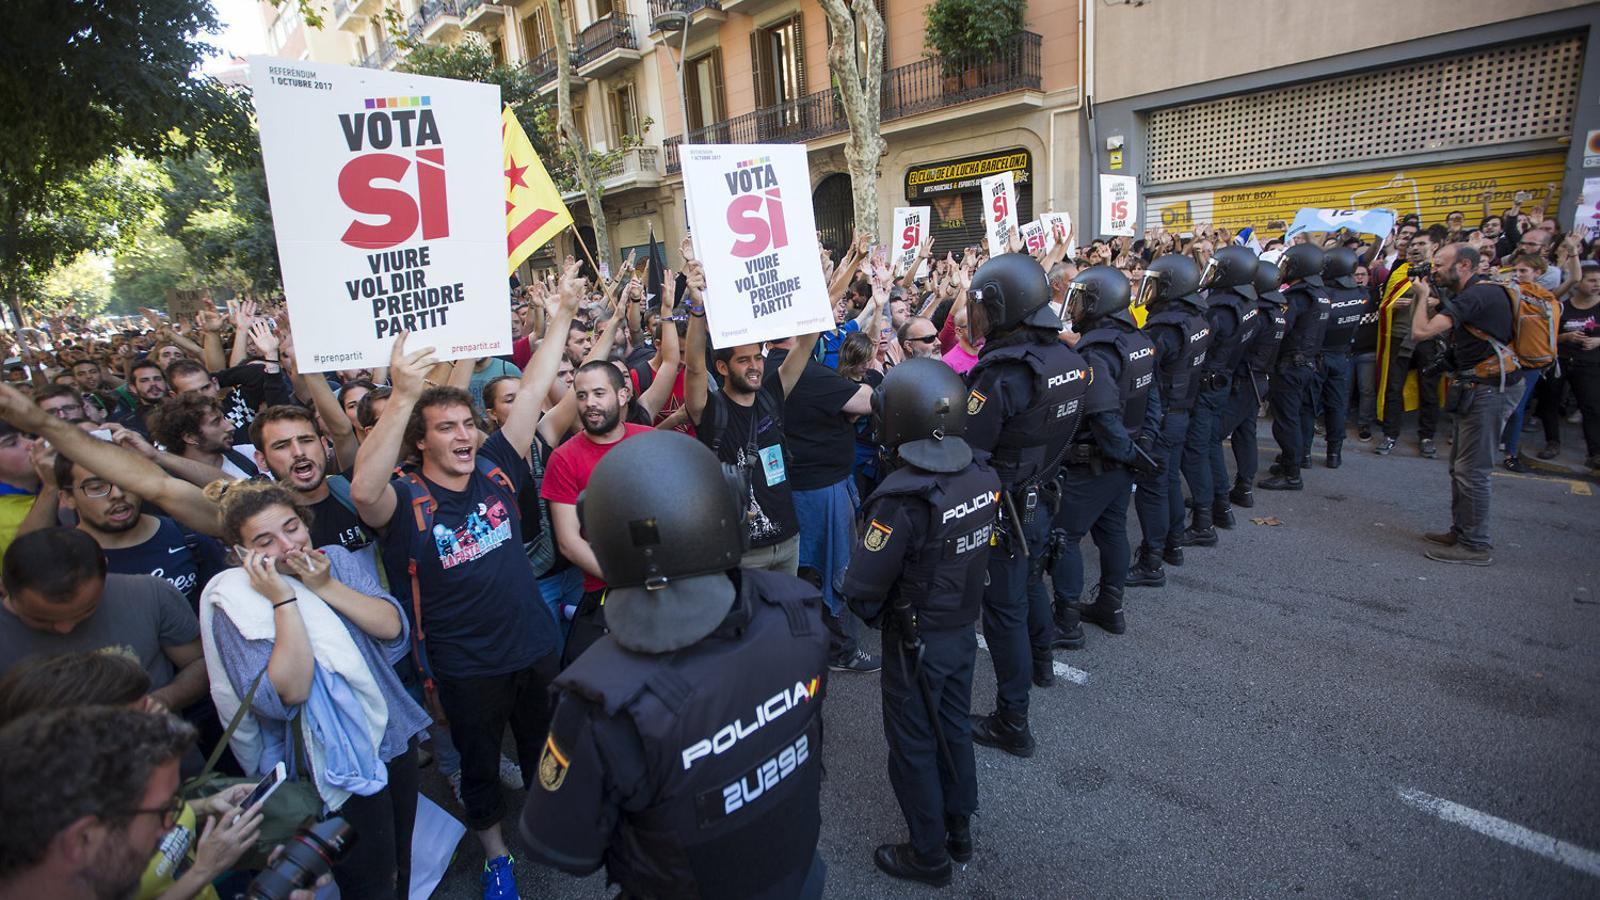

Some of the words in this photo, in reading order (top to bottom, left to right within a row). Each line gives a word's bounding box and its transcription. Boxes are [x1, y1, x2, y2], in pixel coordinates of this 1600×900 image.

[269, 66, 317, 79] REFERENDUM
[271, 76, 275, 84] 1
[277, 77, 313, 89] OCTUBRE
[314, 81, 332, 91] 2017
[338, 109, 441, 151] VOTA
[956, 161, 980, 177] LUCHA
[981, 154, 1026, 173] BARCELONA
[725, 163, 778, 196] VOTA
[992, 182, 1005, 197] VOTA
[1433, 179, 1498, 193] RESERVA
[1220, 195, 1234, 203] OH
[1236, 193, 1252, 202] MY
[1254, 190, 1278, 200] BOX!
[1455, 194, 1471, 204] TU
[904, 214, 920, 227] VOTA
[1026, 226, 1041, 237] VOTA
[367, 246, 430, 275] VIURE
[745, 253, 780, 274] VIURE
[345, 276, 389, 301] VOL
[390, 269, 427, 293] DIR
[735, 275, 759, 294] VOL
[758, 268, 779, 286] DIR
[750, 276, 801, 304] PRENDRE
[372, 283, 465, 318] PRENDRE
[752, 293, 793, 319] PARTIT
[1331, 300, 1362, 309] POLICIA
[375, 306, 449, 339] PARTIT
[313, 351, 363, 364] #prenpartit
[451, 340, 501, 353] prenpartit.cat
[1129, 348, 1154, 361] POLICIA
[1048, 369, 1083, 389] POLICIA
[943, 491, 996, 524] POLICIA
[956, 523, 993, 554] 2U29
[682, 681, 810, 770] POLICIA
[723, 734, 809, 815] 2U292
